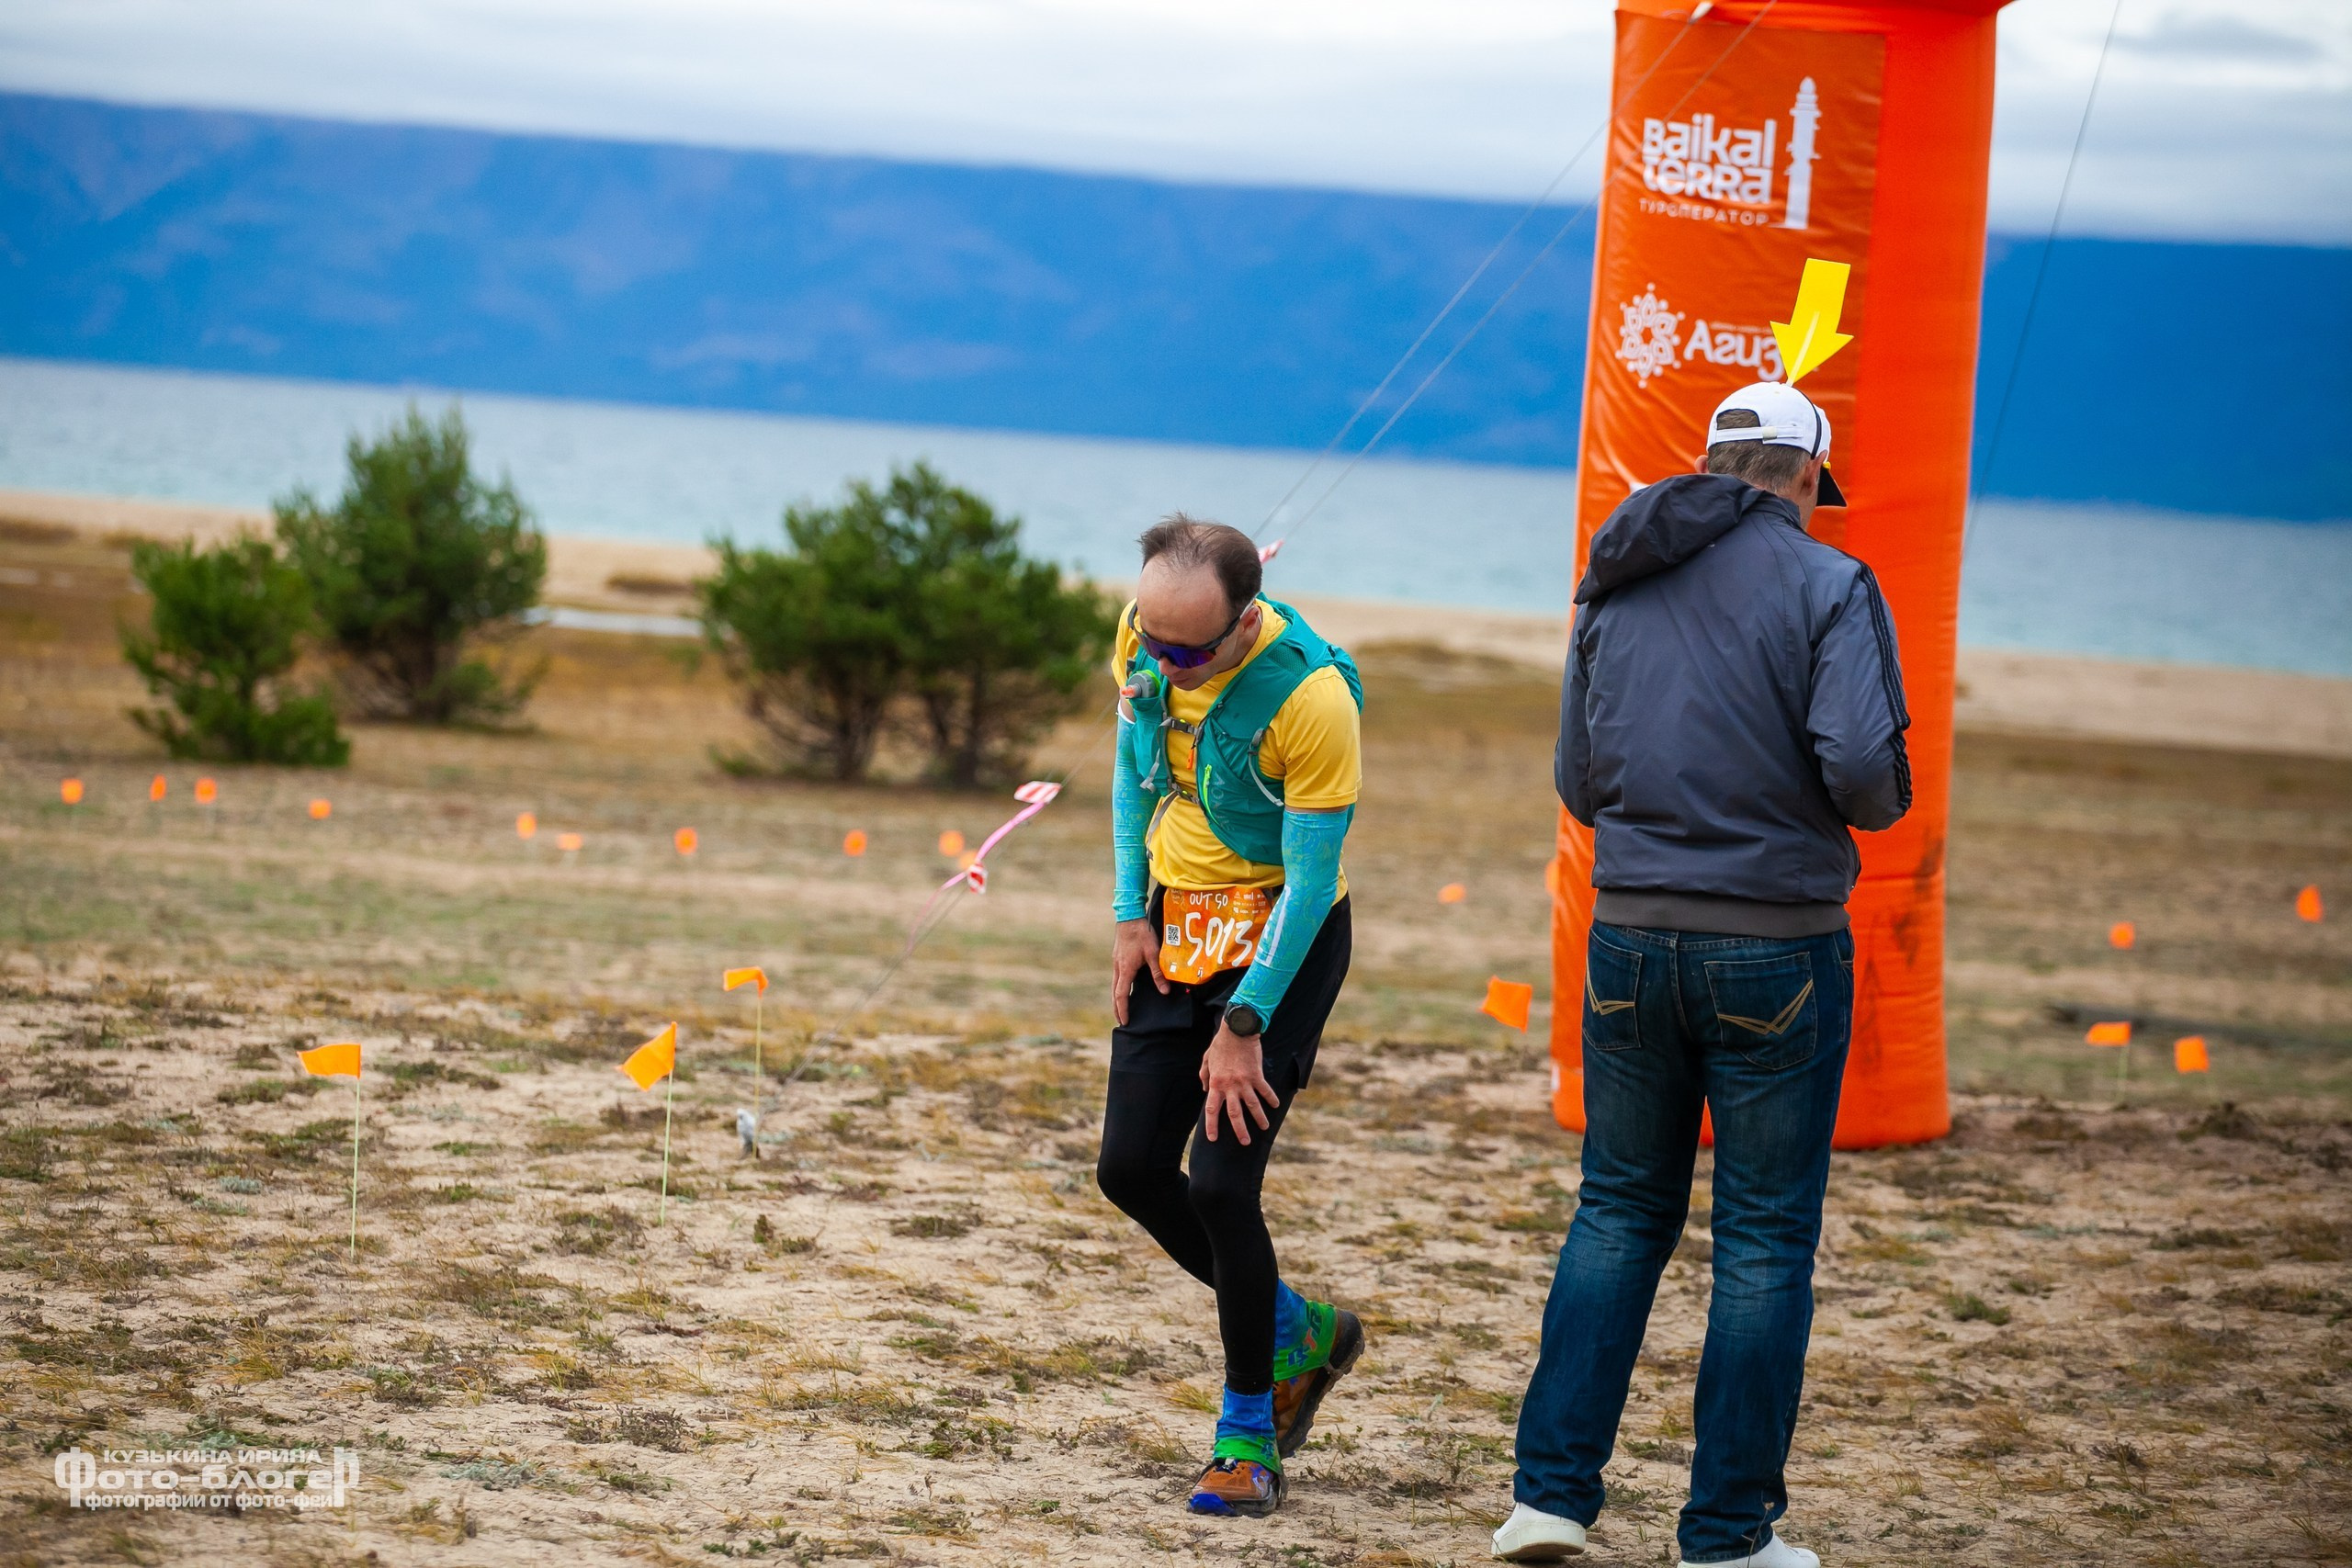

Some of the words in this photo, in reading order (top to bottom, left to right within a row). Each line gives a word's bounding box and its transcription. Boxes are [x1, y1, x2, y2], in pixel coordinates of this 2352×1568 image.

[1643, 112, 1777, 169] Baikal
[1190, 891, 1213, 909] OUT
[1185, 911, 1253, 967] 5013
